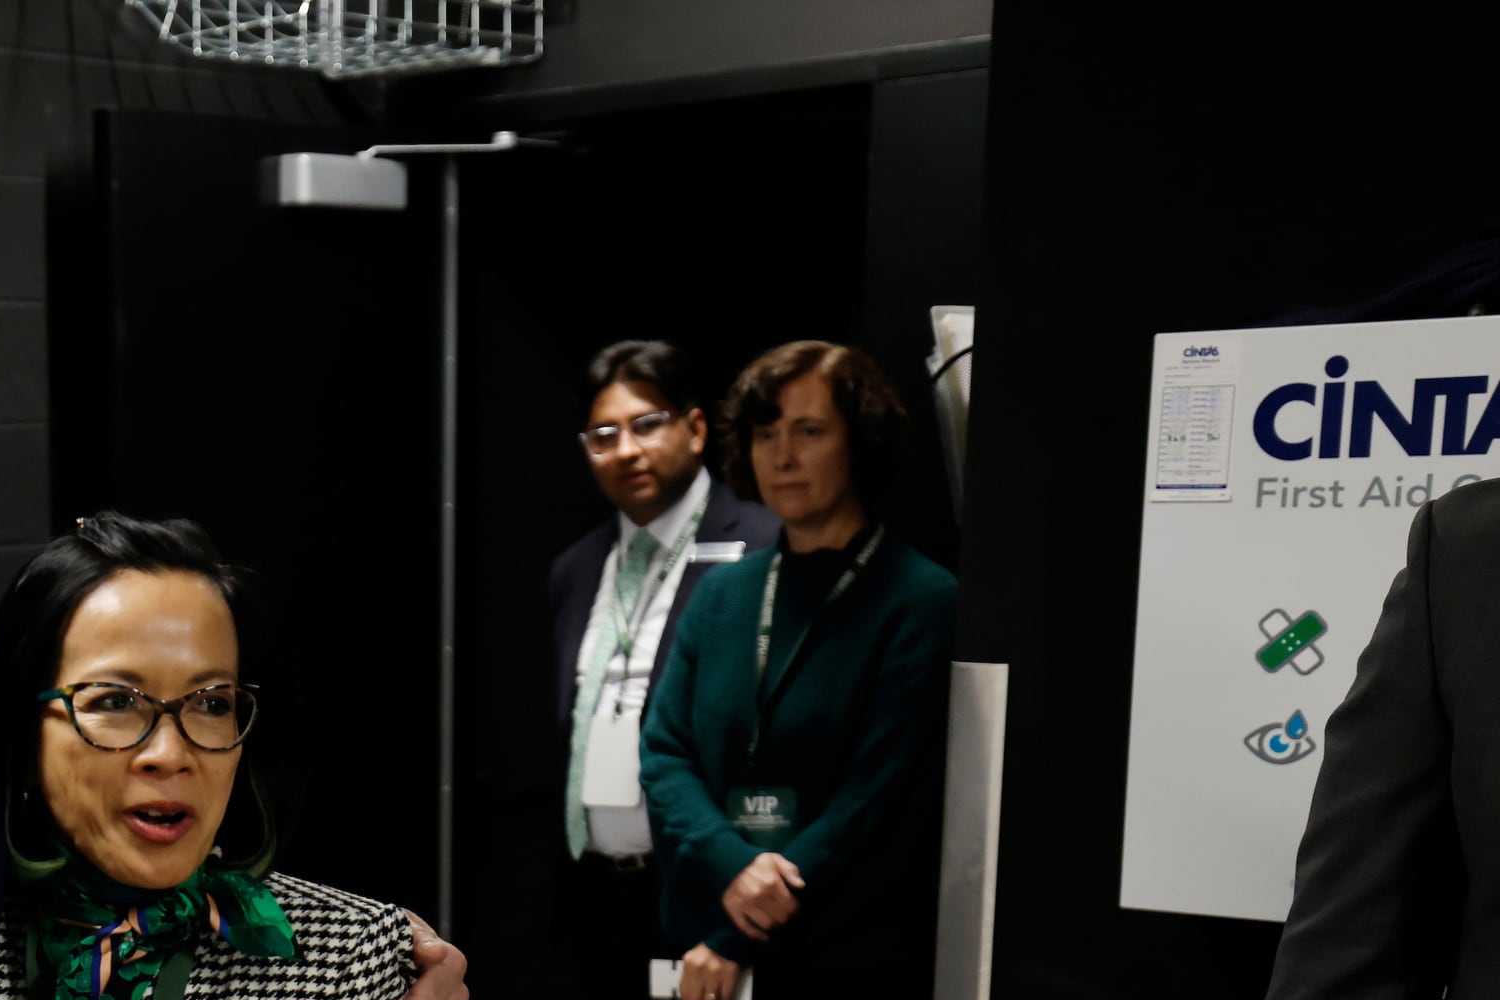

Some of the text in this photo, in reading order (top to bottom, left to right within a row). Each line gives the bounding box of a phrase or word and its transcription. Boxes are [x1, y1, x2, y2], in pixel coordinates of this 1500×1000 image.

[1256, 478, 1345, 508] First
[1358, 473, 1433, 507] Aid
[744, 796, 778, 813] VIP
